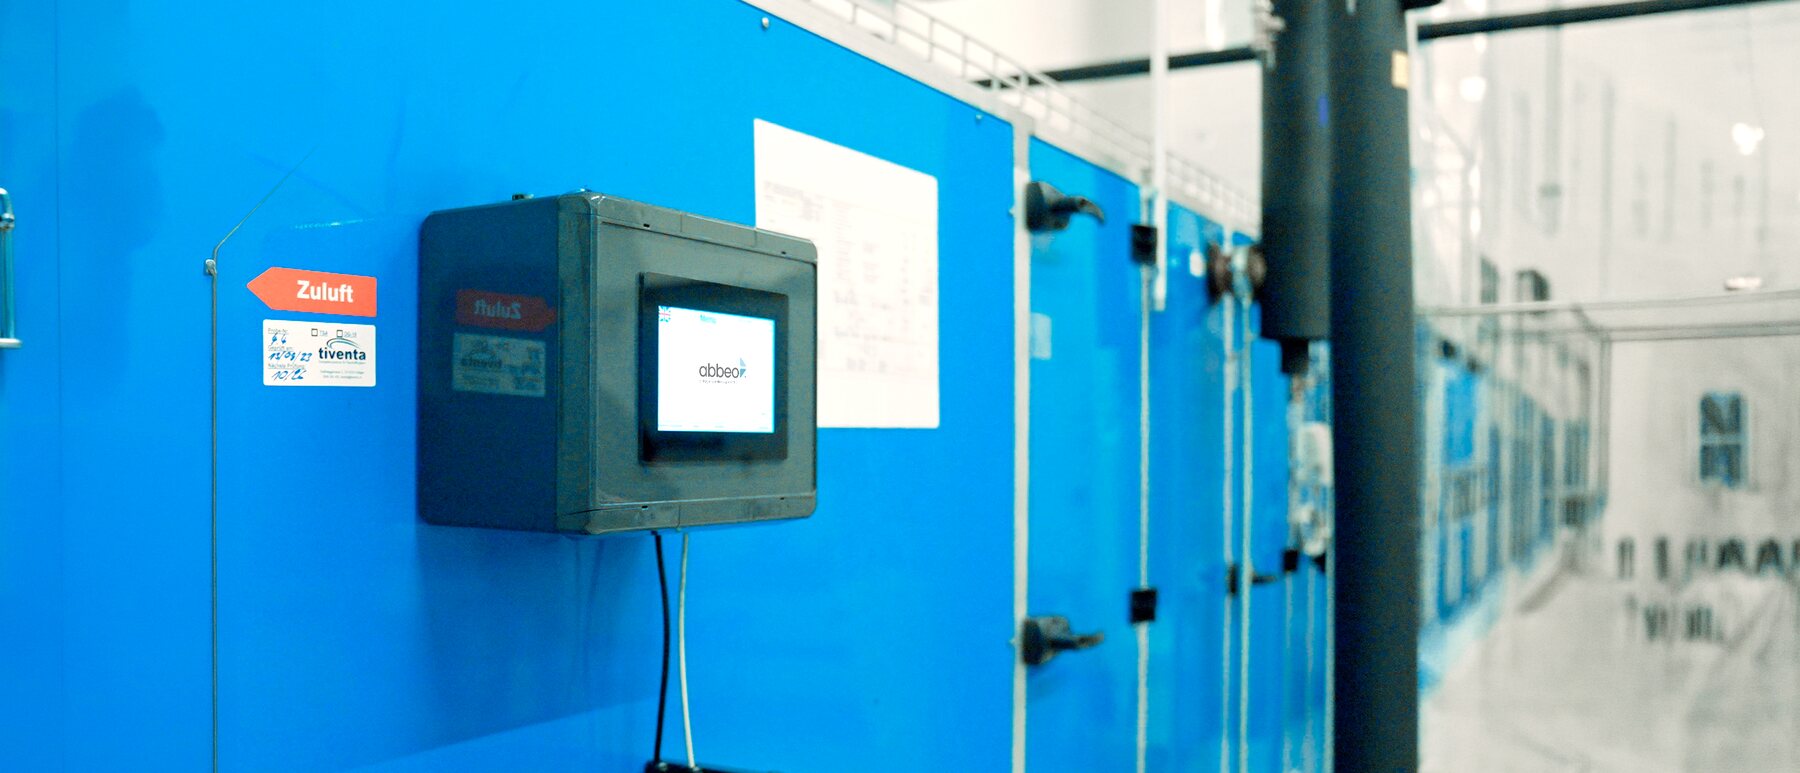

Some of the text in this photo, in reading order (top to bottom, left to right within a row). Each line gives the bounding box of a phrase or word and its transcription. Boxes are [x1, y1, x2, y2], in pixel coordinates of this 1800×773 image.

[296, 279, 353, 303] Zuluft
[318, 346, 367, 360] tiventa
[699, 363, 740, 379] abbeo
